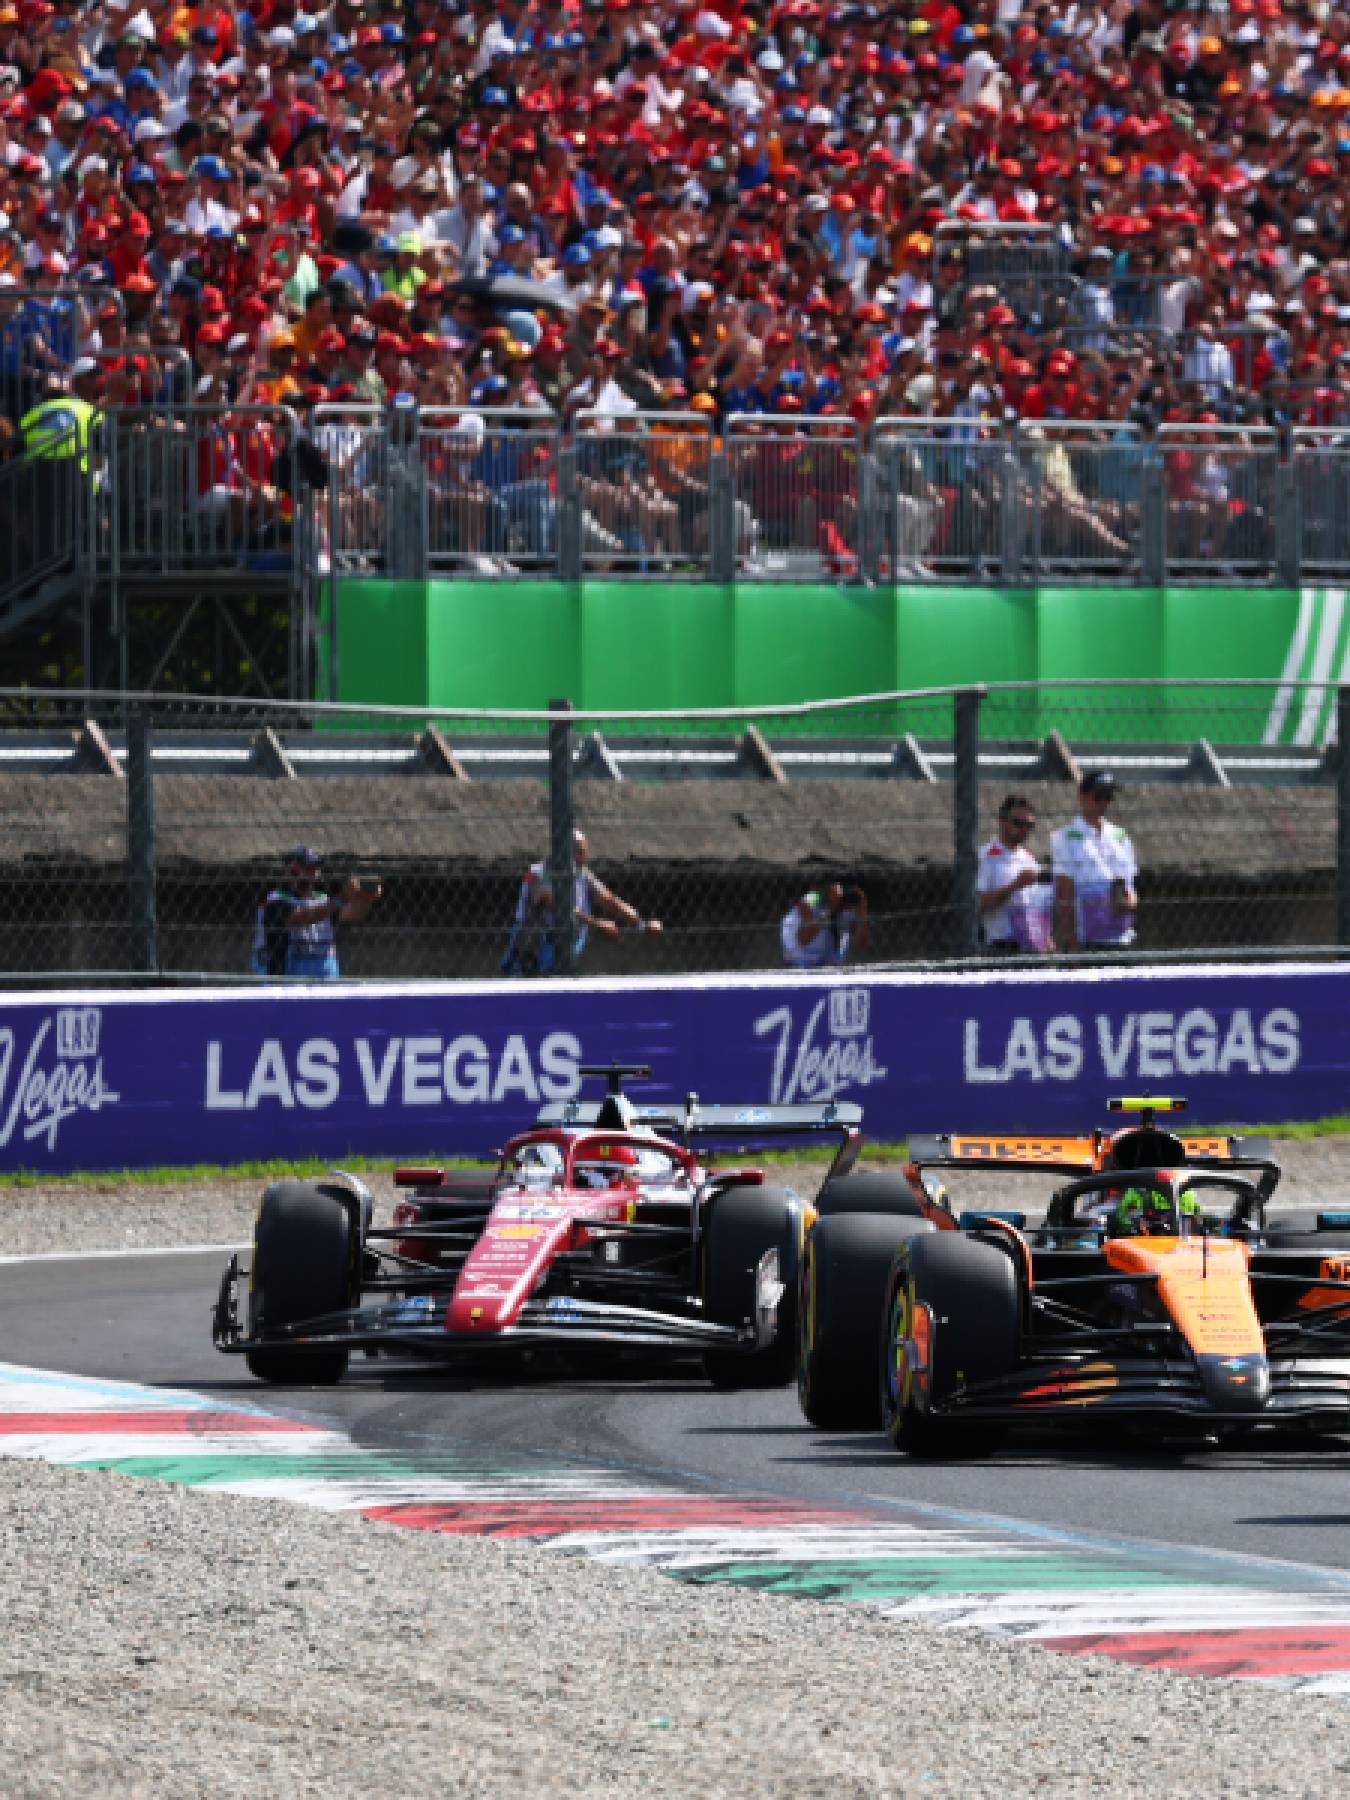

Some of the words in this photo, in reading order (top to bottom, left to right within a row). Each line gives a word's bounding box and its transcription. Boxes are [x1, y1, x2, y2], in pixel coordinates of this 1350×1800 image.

[207, 1038, 339, 1110] LAS
[354, 1032, 582, 1105] VEGAS
[963, 1014, 1083, 1083] LAS
[1095, 1008, 1300, 1077] VEGAS
